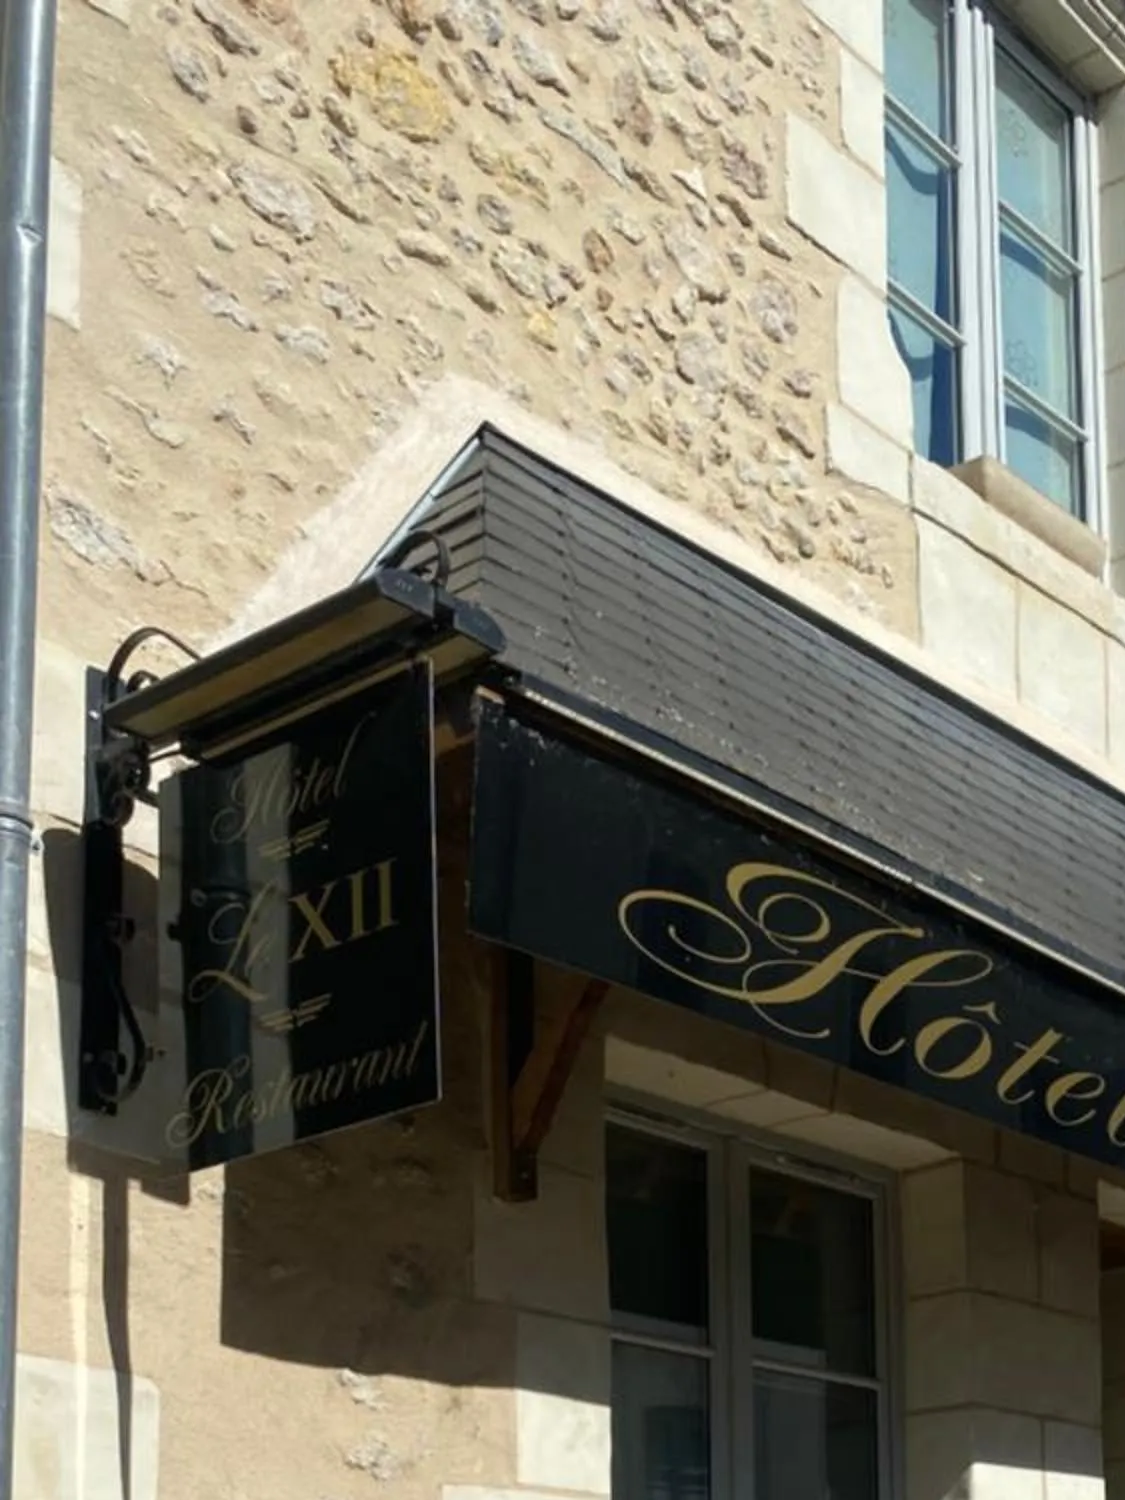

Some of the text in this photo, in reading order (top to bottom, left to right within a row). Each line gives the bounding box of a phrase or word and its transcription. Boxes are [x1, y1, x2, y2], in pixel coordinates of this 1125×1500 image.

[211, 711, 376, 843] Hôtel
[287, 857, 399, 964] XII
[165, 1020, 429, 1149] Restaurant
